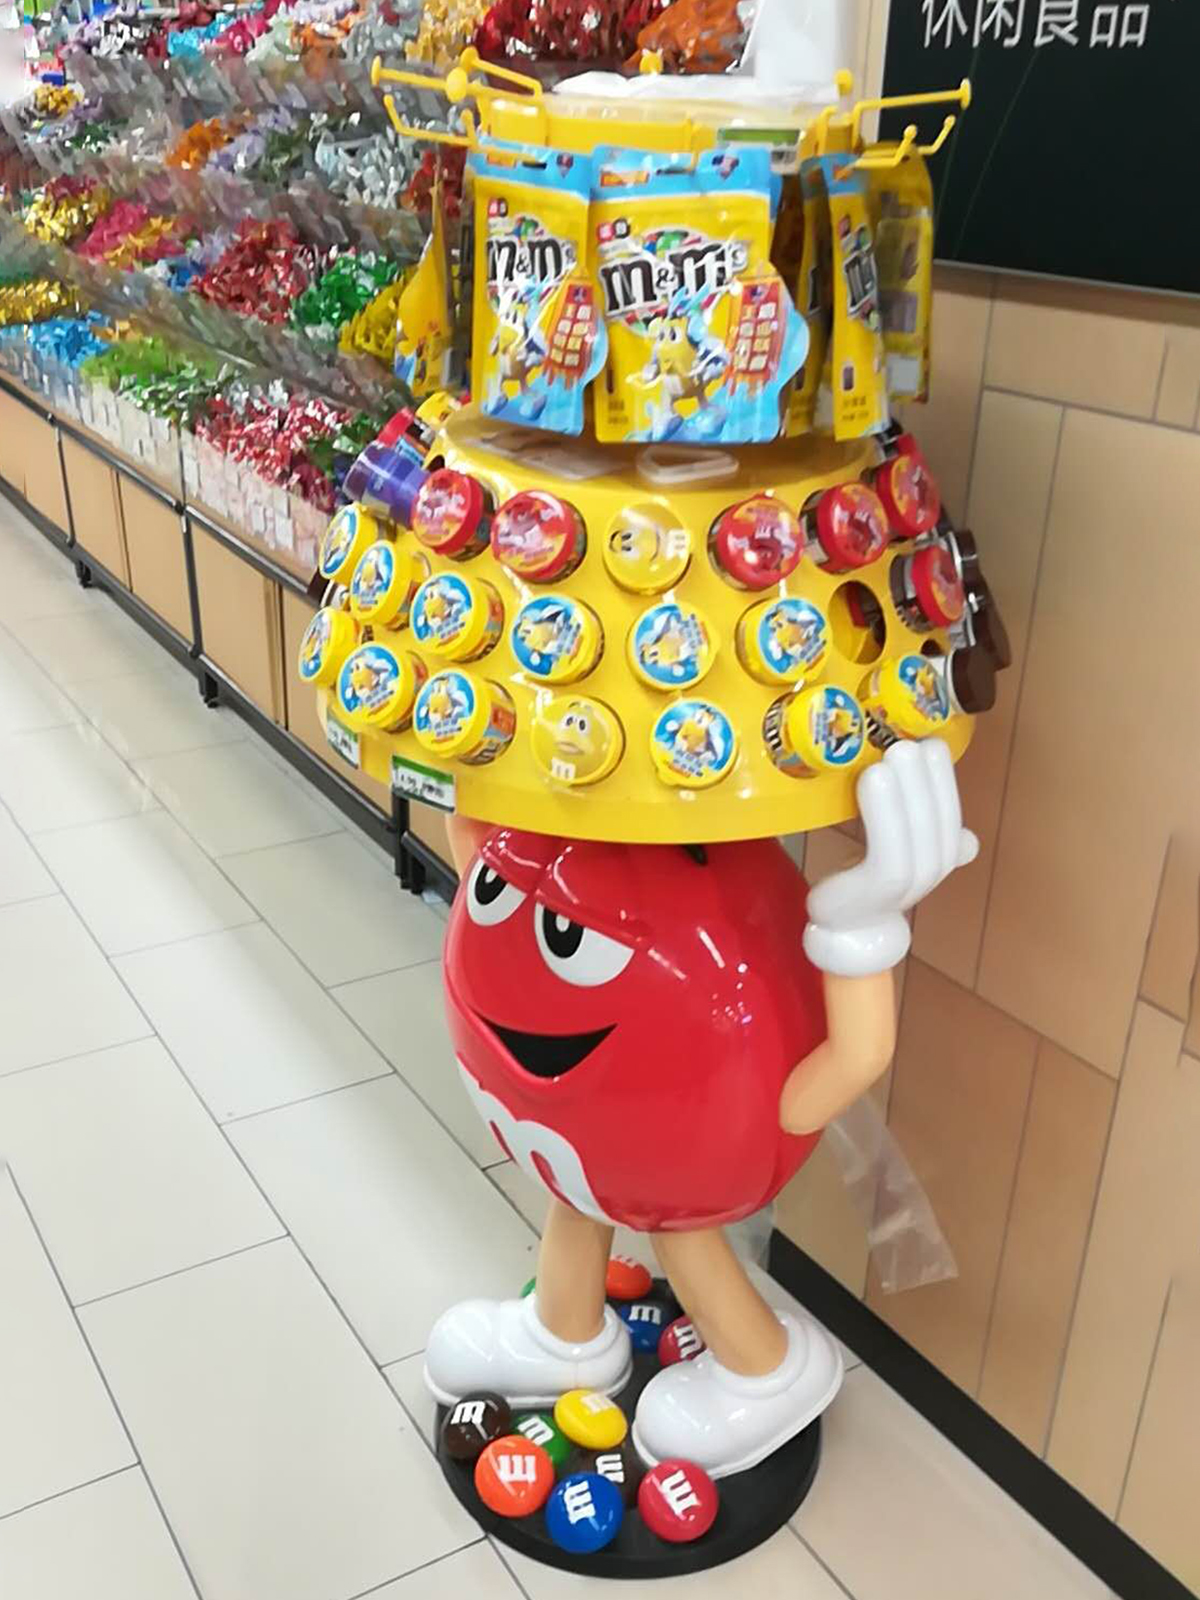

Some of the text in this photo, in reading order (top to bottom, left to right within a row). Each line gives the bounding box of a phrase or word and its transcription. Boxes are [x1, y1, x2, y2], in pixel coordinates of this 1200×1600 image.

[628, 1305, 661, 1325] m
[450, 1401, 486, 1425] m
[581, 1393, 615, 1415] m
[517, 1415, 555, 1446] m
[496, 1454, 537, 1483] m
[595, 1453, 625, 1483] m
[563, 1480, 597, 1525] m
[660, 1470, 701, 1521] m
